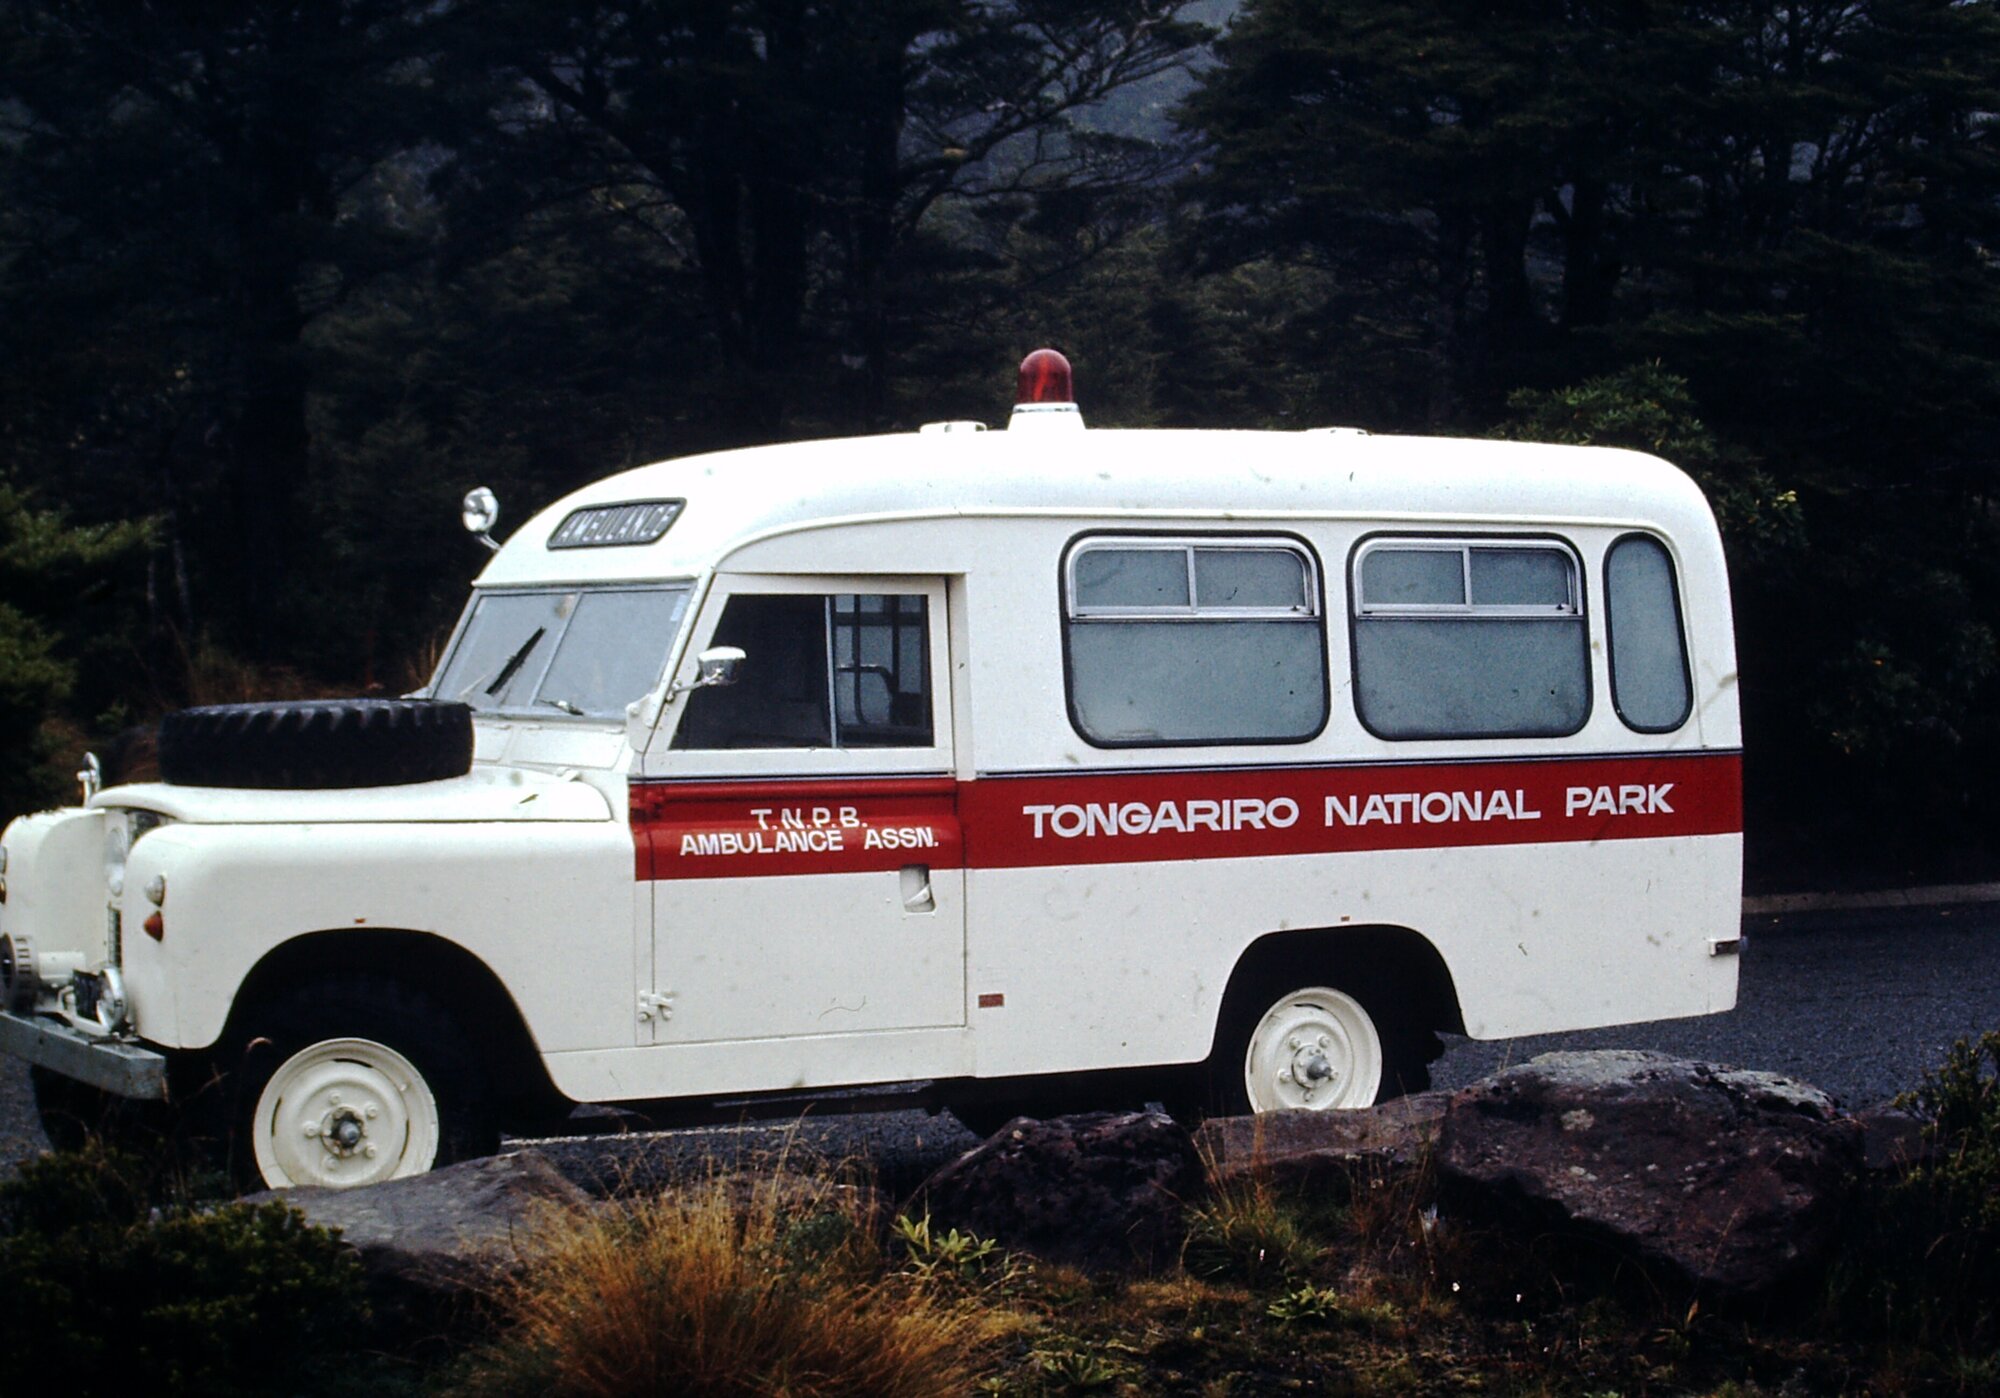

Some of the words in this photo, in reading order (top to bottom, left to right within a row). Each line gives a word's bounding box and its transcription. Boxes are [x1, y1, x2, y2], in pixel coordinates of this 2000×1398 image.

[555, 503, 679, 543] AMBULANCE
[750, 806, 868, 831] T.N.P.B.
[1022, 796, 1300, 839] TONGARIRO
[1324, 789, 1542, 827] NATIONAL
[1565, 783, 1675, 818] PARK
[679, 829, 844, 856] AMBULANCE
[863, 827, 940, 851] ASSN.
